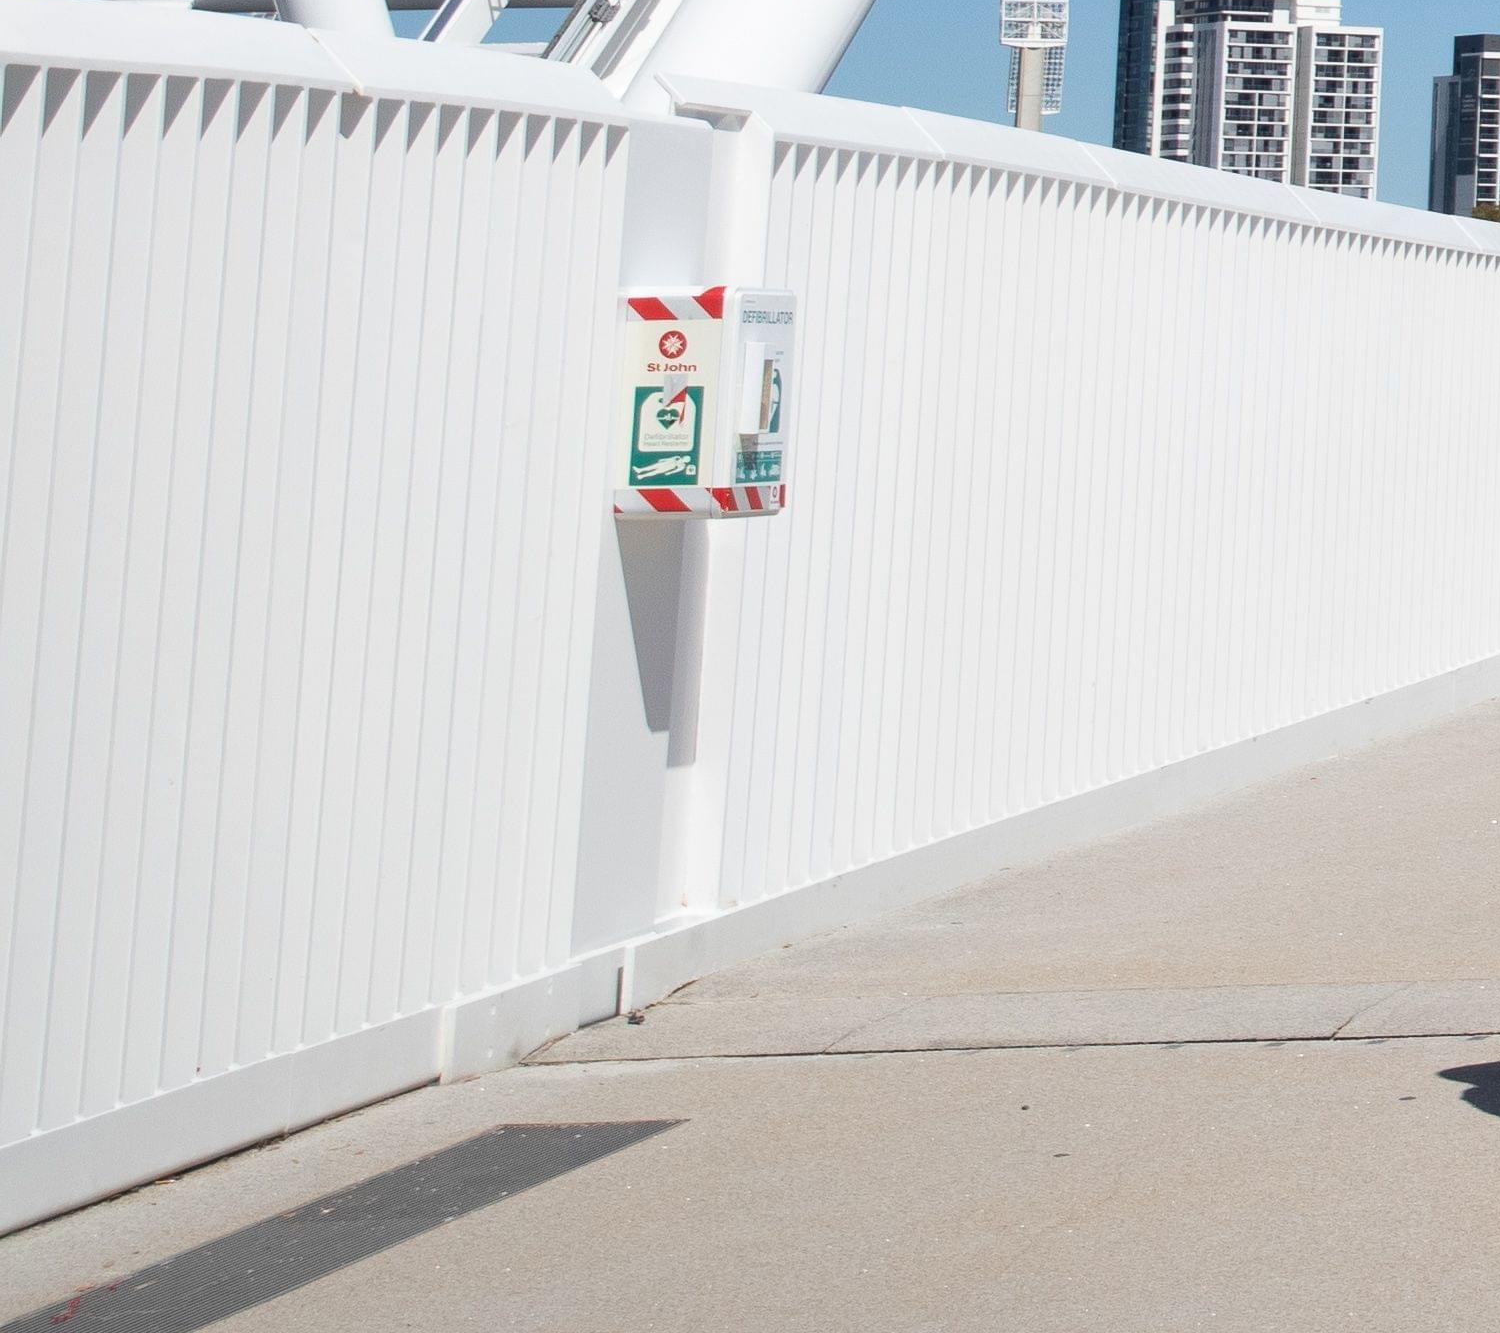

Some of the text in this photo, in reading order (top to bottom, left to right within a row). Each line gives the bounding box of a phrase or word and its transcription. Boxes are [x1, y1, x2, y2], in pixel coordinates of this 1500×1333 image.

[742, 310, 794, 325] DEFIBRILLATOR
[647, 363, 697, 372] St John
